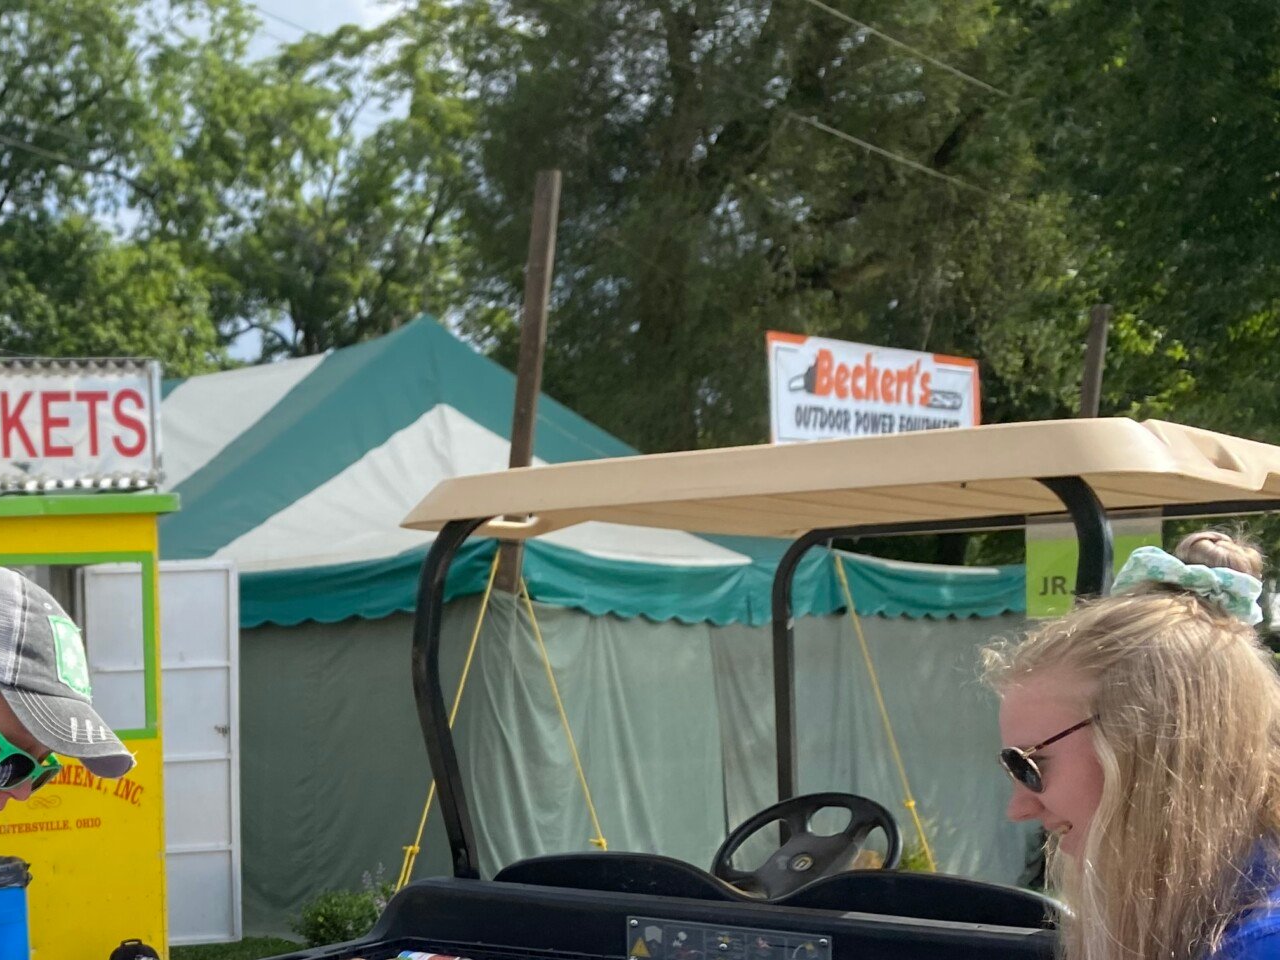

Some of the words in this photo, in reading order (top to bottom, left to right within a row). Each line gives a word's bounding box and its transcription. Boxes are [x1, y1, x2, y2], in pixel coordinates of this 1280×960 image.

[815, 349, 931, 407] Beckert's
[795, 405, 851, 434] OUTDOOR
[855, 410, 896, 434] POWER
[114, 777, 144, 806] INC.
[76, 817, 101, 829] OHIO
